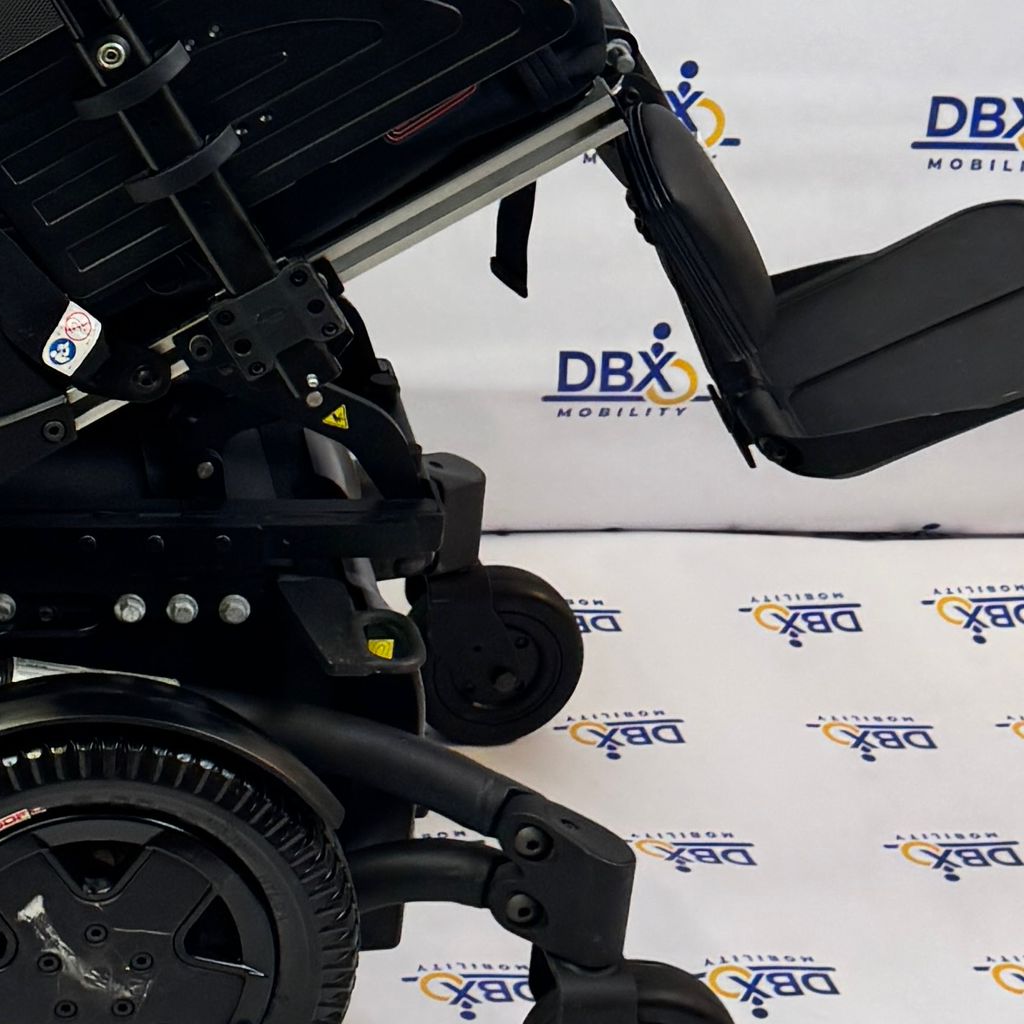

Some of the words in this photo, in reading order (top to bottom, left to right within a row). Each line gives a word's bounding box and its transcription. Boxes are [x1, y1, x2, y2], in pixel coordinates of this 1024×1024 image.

[557, 350, 676, 394] DBX
[556, 407, 687, 418] MOBILITY
[752, 592, 844, 602] MOBILITY
[773, 608, 864, 635] DBX
[566, 709, 666, 722] MOBILITY
[819, 715, 916, 724] MOBILITY
[587, 724, 686, 748] DBX
[843, 729, 938, 752] DBX
[631, 831, 734, 839] MOBILITY
[896, 832, 999, 841] MOBILITY
[655, 847, 758, 866] DBX
[920, 847, 1024, 869] DBX
[703, 954, 815, 967] MOBILITY
[728, 972, 841, 1003] DBX
